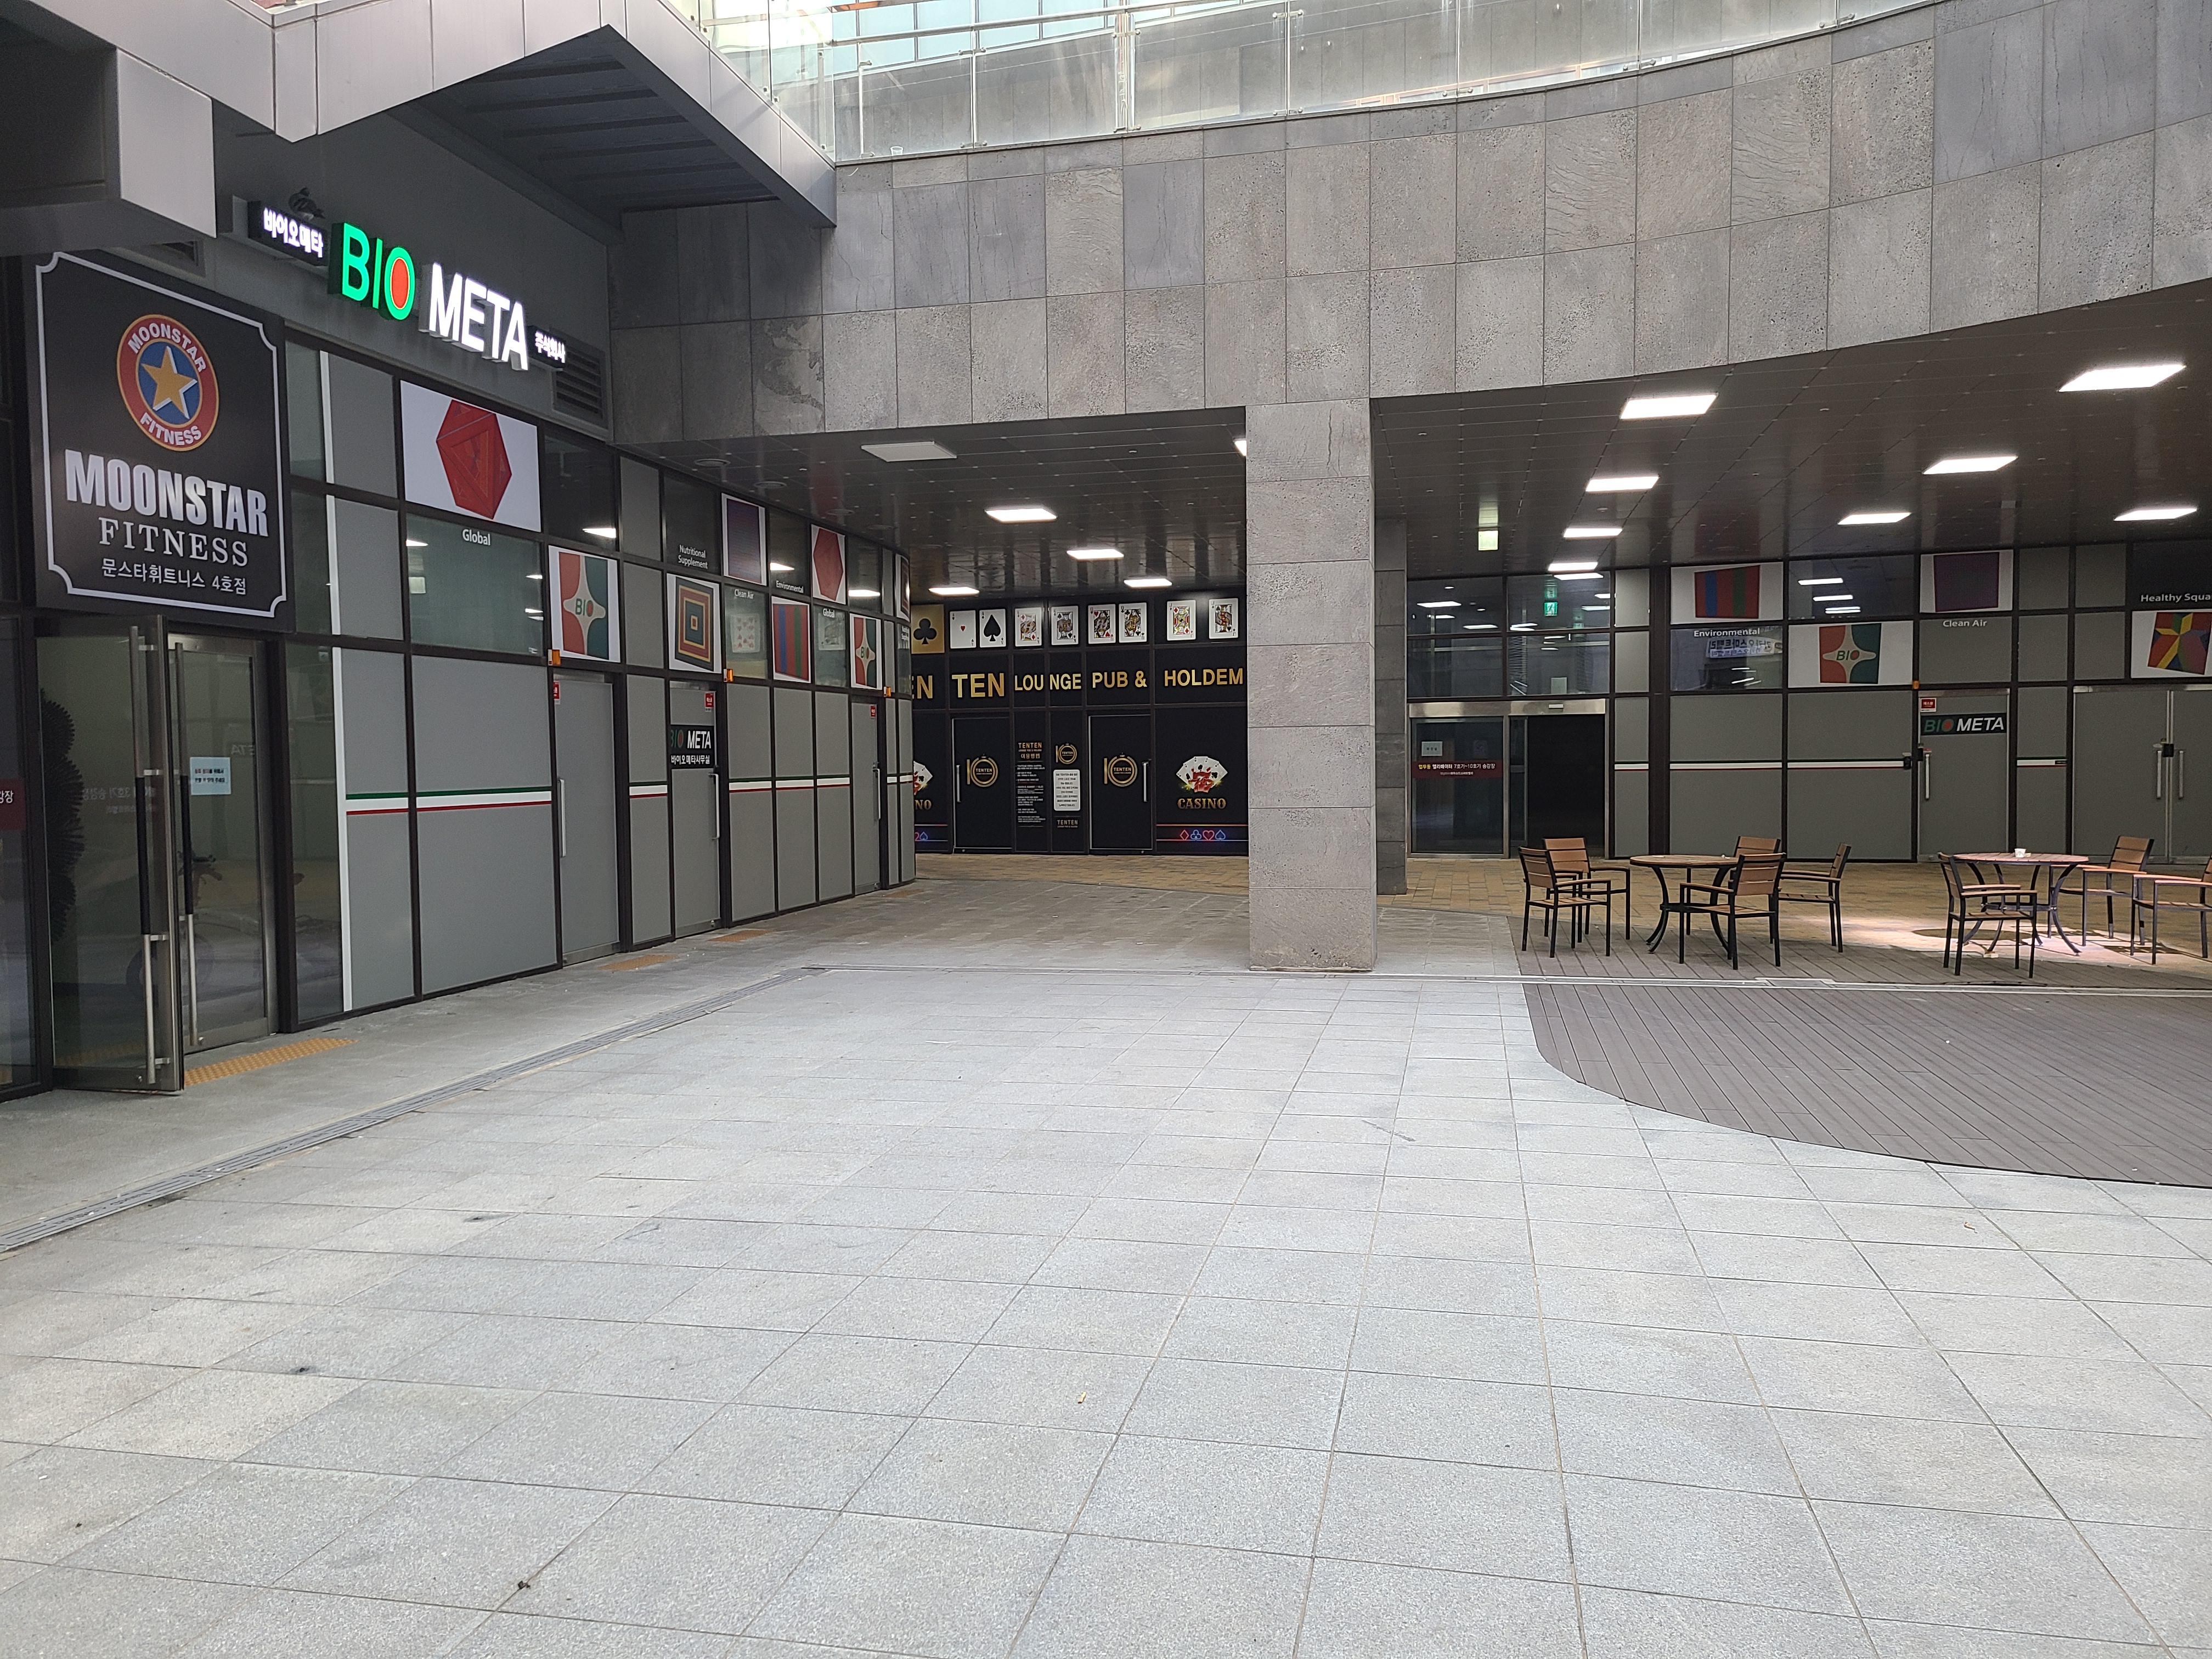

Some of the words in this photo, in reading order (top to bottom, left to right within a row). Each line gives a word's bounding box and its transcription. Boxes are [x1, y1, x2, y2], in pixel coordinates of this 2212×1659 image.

[263, 207, 323, 258] 바이오메타
[342, 221, 415, 320] BIO
[429, 261, 528, 371] META
[128, 323, 206, 372] MOONSTAR
[140, 412, 201, 445] FITNESS
[65, 449, 269, 537] MOONSTAR
[98, 517, 248, 567] FITNESS
[462, 528, 492, 546] Global
[679, 544, 706, 559] Nutritional
[678, 555, 708, 569] Supplement
[101, 557, 206, 588] 문스타휘트니스
[212, 575, 246, 595] 4호점
[734, 589, 747, 599] Clean
[776, 580, 804, 594] Environmental
[2141, 594, 2182, 603] Healthy
[2184, 593, 2212, 602] Squa
[575, 598, 594, 617] BIO
[823, 608, 835, 618] Global
[1943, 619, 1969, 628] Clean
[1972, 619, 1987, 628] Air
[1694, 628, 1760, 637] Environmental
[860, 646, 870, 659] BIO
[1836, 650, 1860, 661] BIO
[912, 675, 933, 699] N
[951, 673, 1005, 698] TEN
[1092, 671, 1128, 688] PUB
[1135, 670, 1147, 687] &
[1164, 668, 1243, 686] HOLDEM
[1923, 718, 1954, 732] BIO
[1956, 717, 2004, 732] META
[687, 730, 712, 749] META
[671, 755, 710, 765] 바이오메타사무실
[1177, 798, 1226, 809] CASINO
